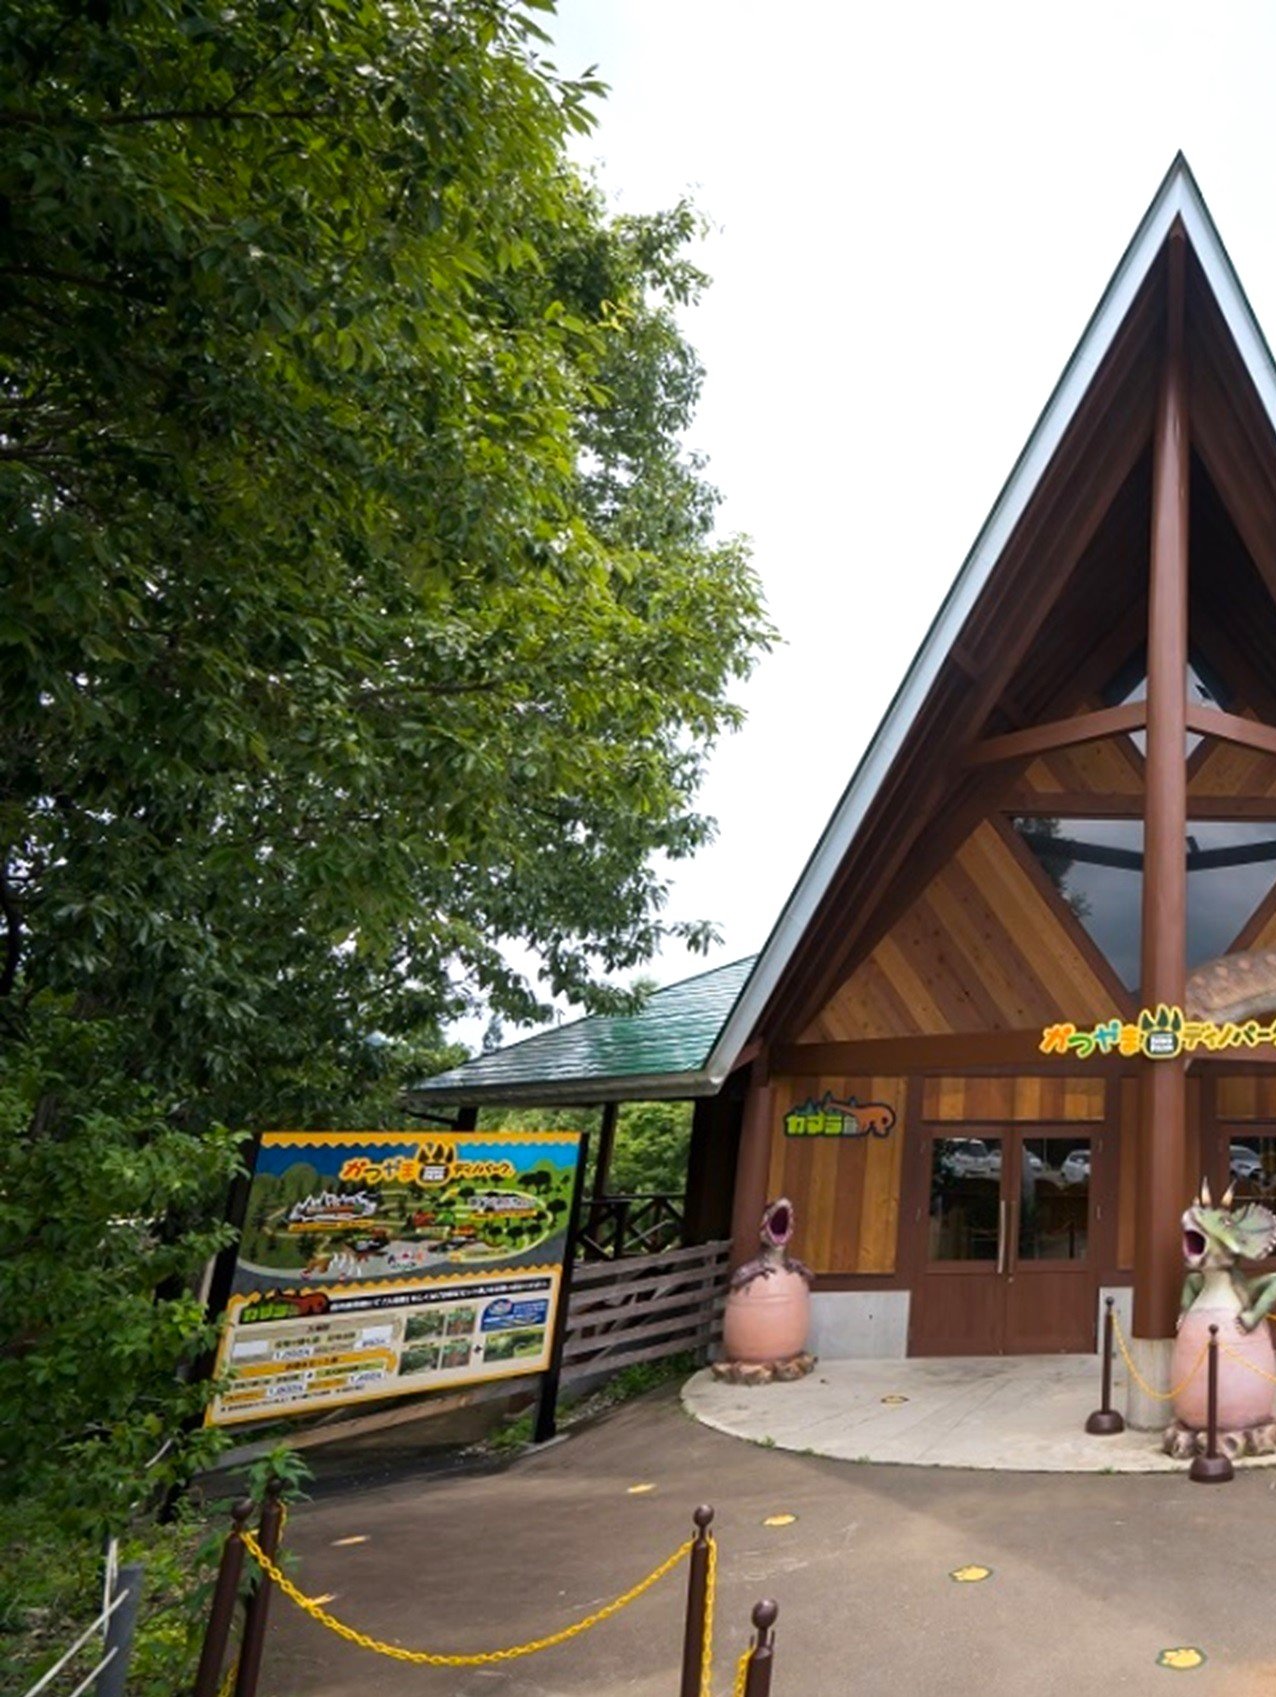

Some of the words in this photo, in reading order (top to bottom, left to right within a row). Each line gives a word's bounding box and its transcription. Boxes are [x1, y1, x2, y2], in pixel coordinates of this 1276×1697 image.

[1040, 1019, 1140, 1058] かつやま
[340, 1157, 418, 1183] かつやま
[453, 1161, 515, 1177] ディノパーク
